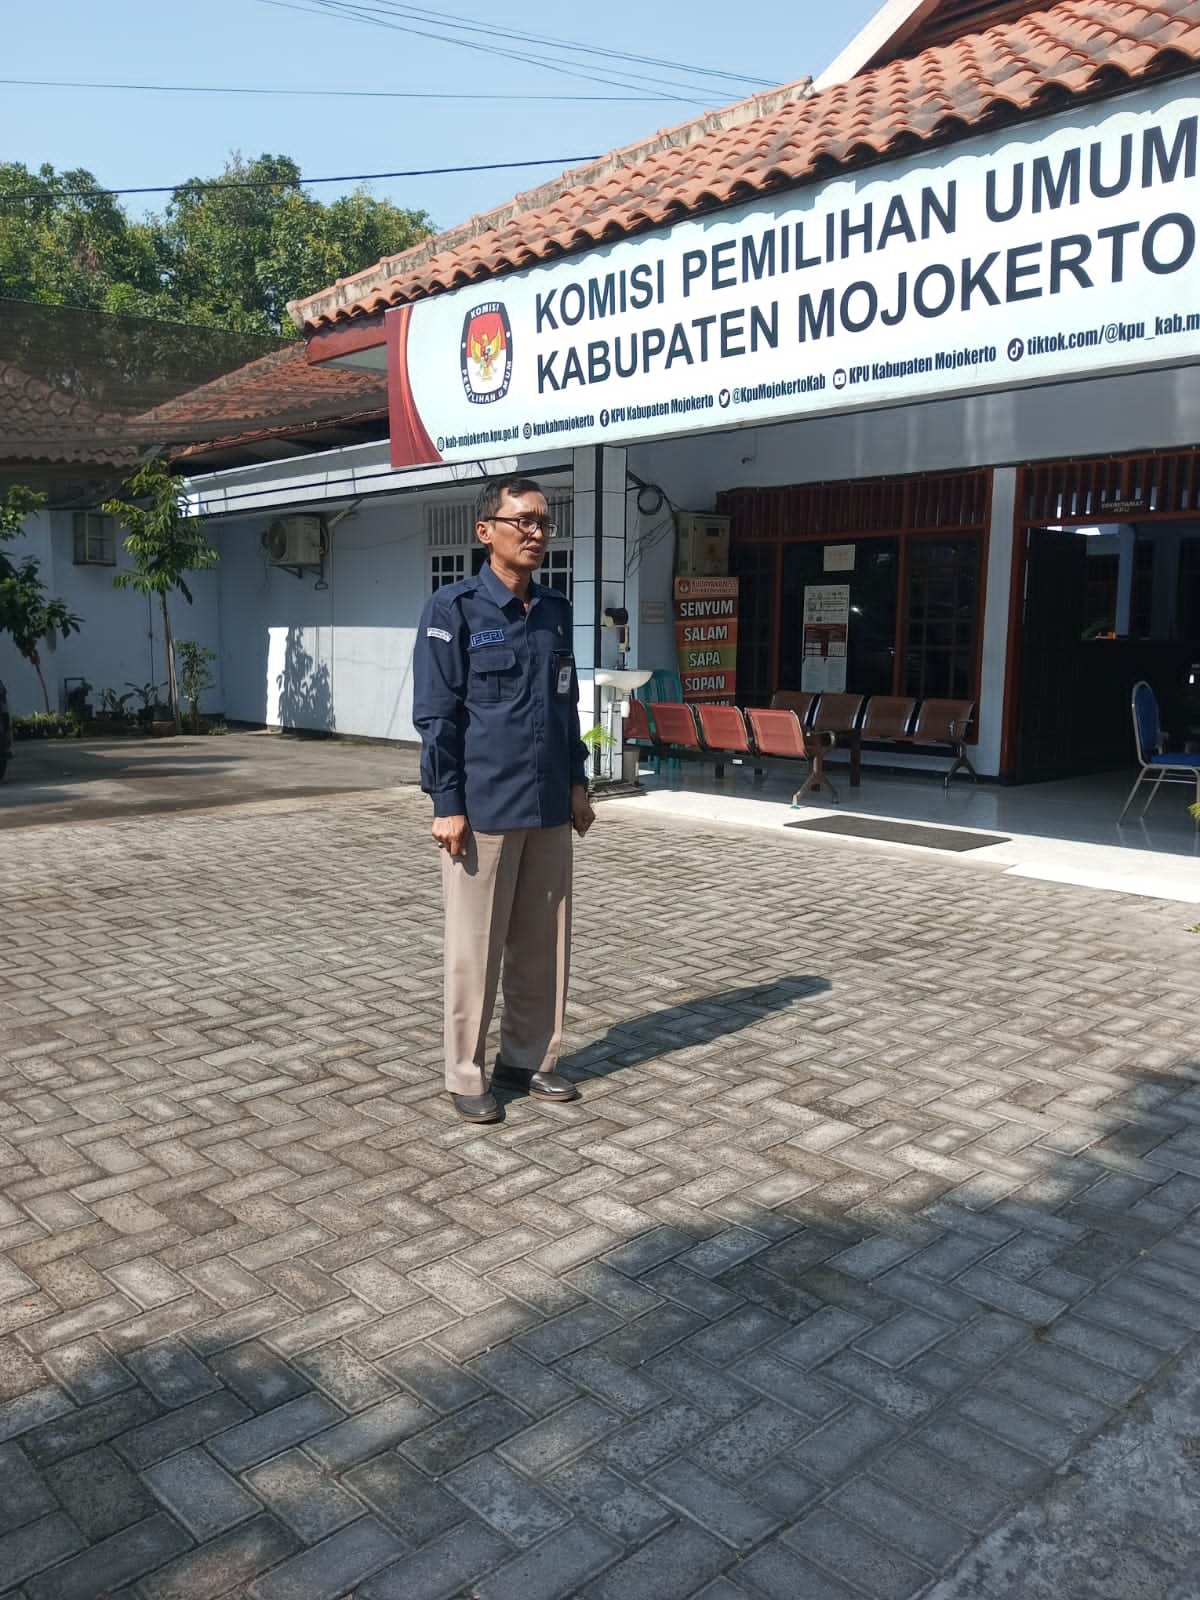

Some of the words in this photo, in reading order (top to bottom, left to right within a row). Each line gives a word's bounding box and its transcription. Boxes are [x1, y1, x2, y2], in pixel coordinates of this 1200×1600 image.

[535, 259, 664, 334] KOMISI
[682, 180, 957, 298] PEMILIHAN
[985, 115, 1199, 223] UMUM
[470, 303, 500, 319] KOMISI
[537, 301, 779, 394] KABUPATEN
[798, 212, 1196, 343] MOJOKERTO
[849, 365, 869, 384] KPU
[872, 353, 932, 380] Kabupaten
[935, 346, 997, 370] Mojokerto
[733, 373, 826, 404] @KpuMojokertoKab
[611, 409, 626, 423] KPU
[627, 401, 670, 421] Kabupaten
[671, 394, 714, 413] Mojokerto
[680, 600, 733, 617] SENYUM
[684, 626, 728, 641] SALAM
[689, 652, 720, 667] SAPA
[685, 676, 725, 691] SOPAN
